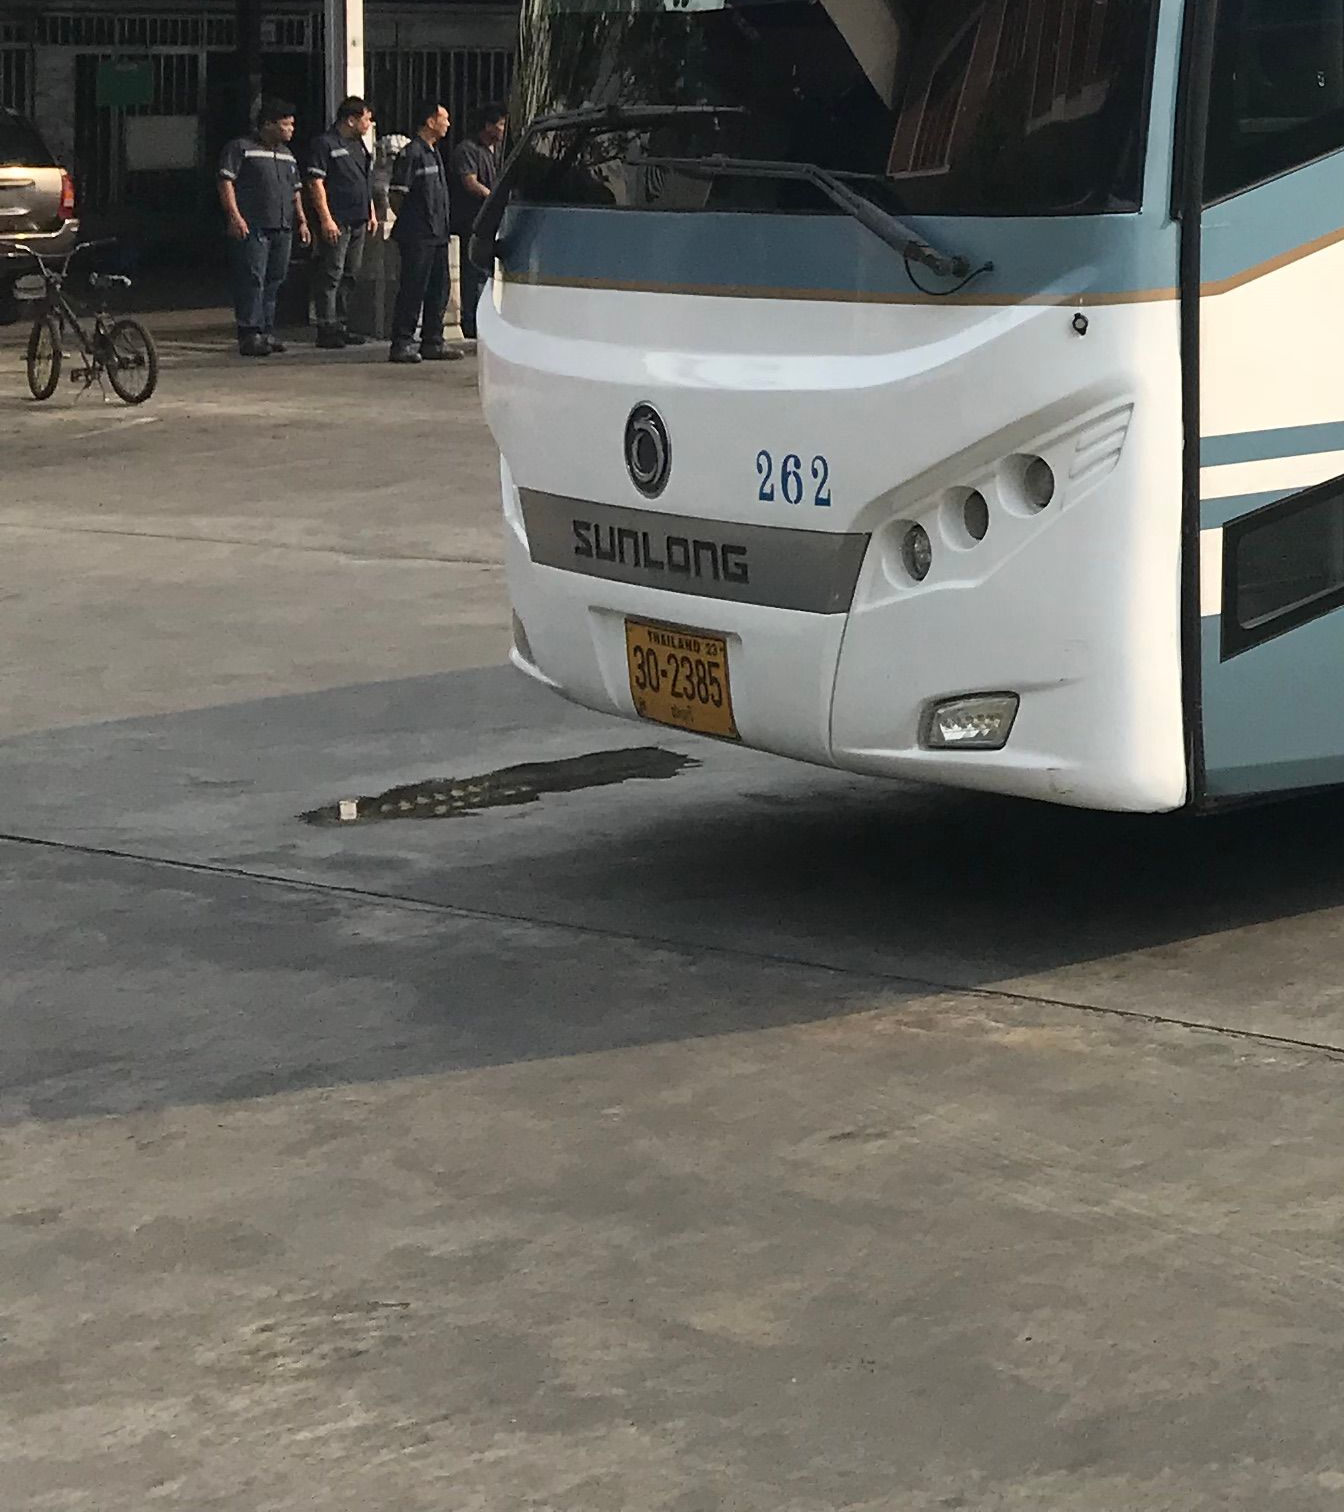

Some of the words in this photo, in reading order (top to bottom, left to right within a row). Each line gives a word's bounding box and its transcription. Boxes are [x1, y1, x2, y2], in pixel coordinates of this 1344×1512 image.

[756, 449, 831, 506] 262
[572, 519, 750, 584] SUNLONG
[633, 645, 723, 708] 30-2385
